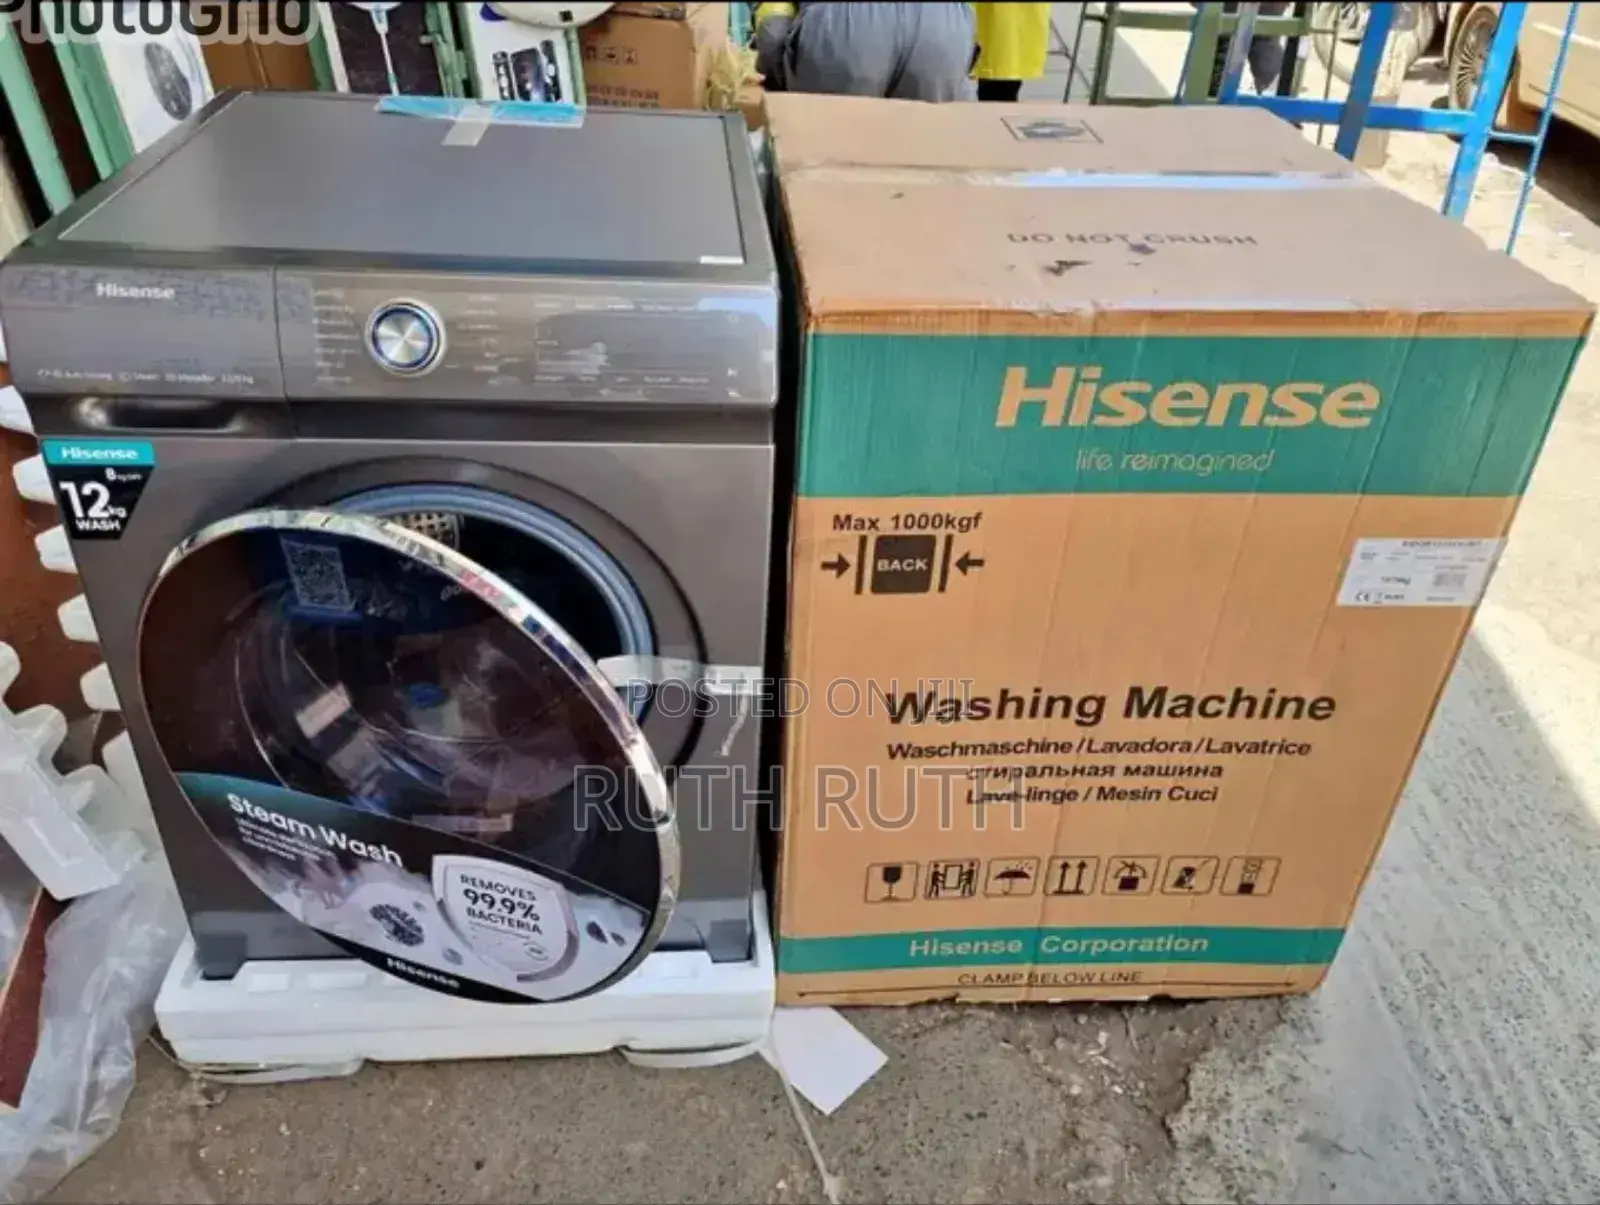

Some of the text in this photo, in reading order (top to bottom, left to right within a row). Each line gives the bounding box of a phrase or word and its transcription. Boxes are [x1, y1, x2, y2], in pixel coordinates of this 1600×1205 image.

[96, 281, 175, 299] Hisense
[996, 365, 1381, 429] Hisense
[61, 446, 139, 460] Hisense
[1075, 447, 1275, 477] life reimagined
[75, 519, 121, 532] WASH
[832, 512, 983, 533] Max 1000kgf
[877, 558, 929, 573] BACK
[885, 686, 1337, 727] Washing Machine
[1122, 764, 1224, 778] машина
[1095, 785, 1162, 803] Mesin
[1167, 785, 1220, 802] Cuci
[227, 792, 316, 841] Steam
[318, 823, 403, 869] Wash
[460, 873, 537, 901] REMOVES
[463, 888, 541, 922] 99.9%
[466, 906, 543, 936] BACTERIA
[910, 934, 1209, 957] Hisense Corporation
[386, 957, 460, 989] Hisense
[957, 971, 1143, 985] CLAMP BELOW LINE
